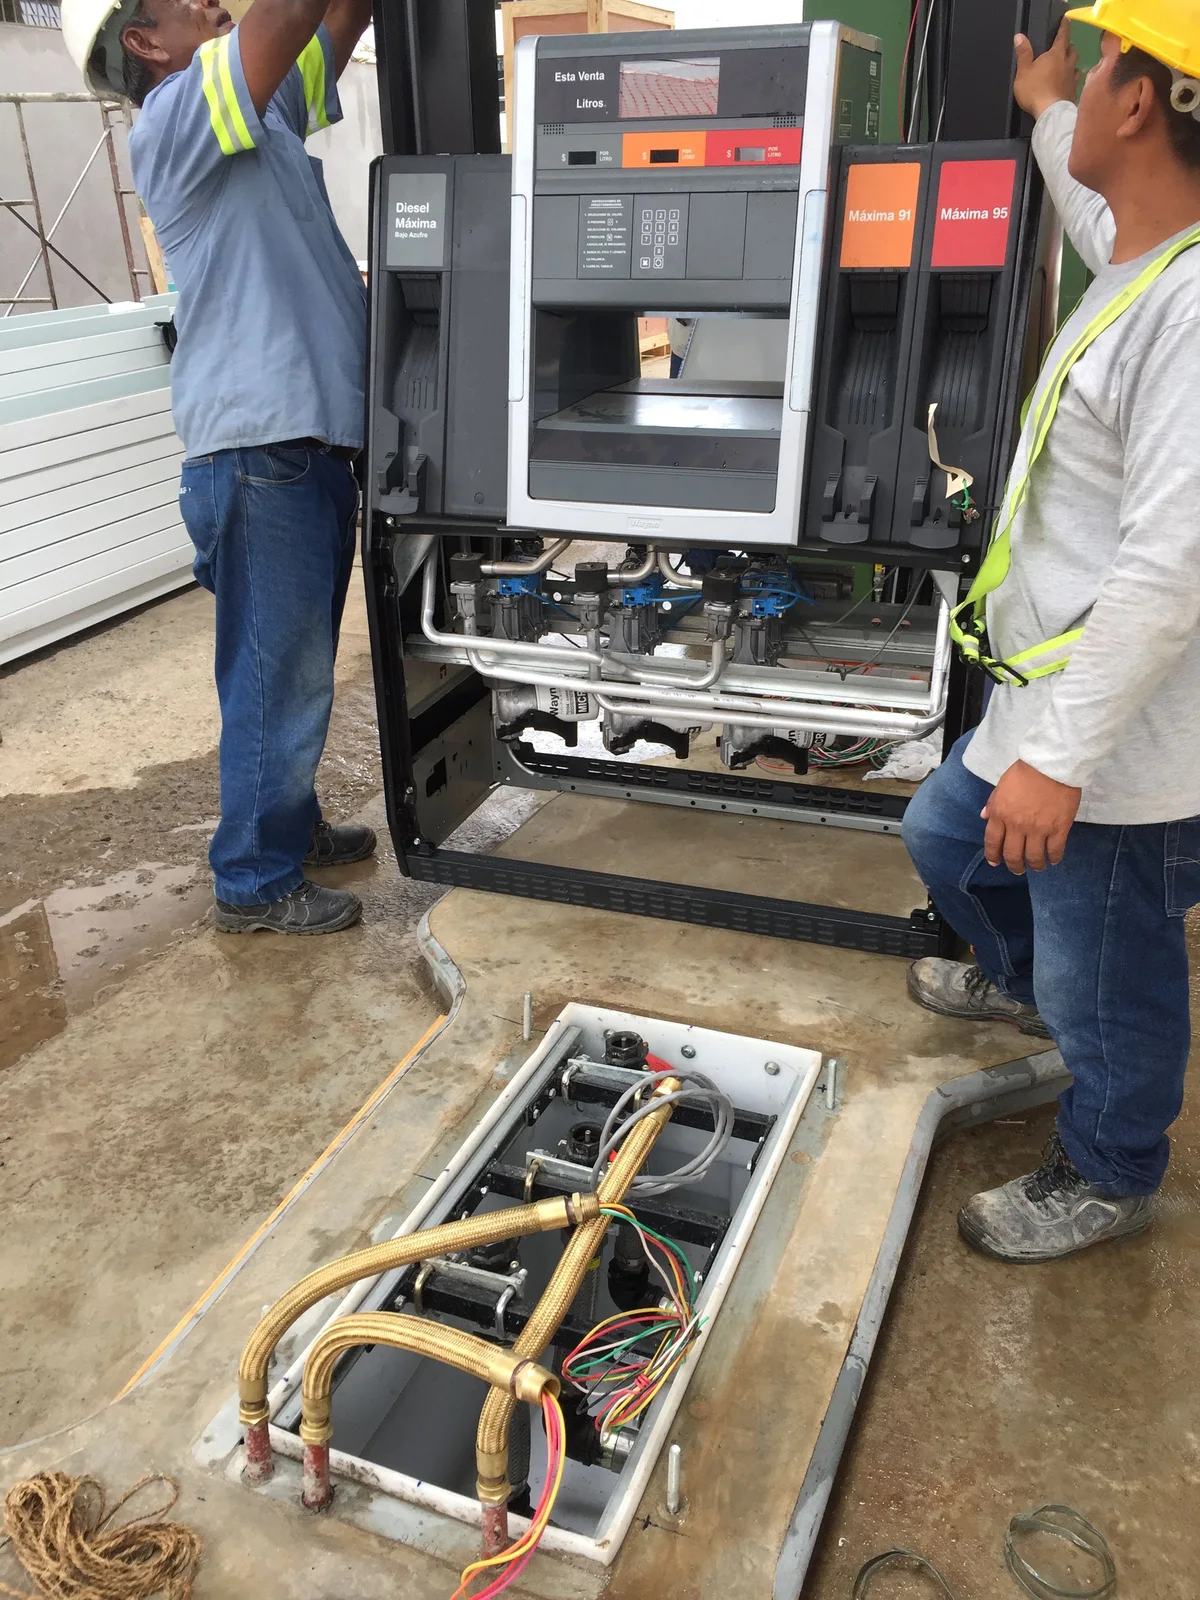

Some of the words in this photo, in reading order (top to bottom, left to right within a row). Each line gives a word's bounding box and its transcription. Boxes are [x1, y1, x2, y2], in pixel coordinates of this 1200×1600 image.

[555, 72, 575, 82] Esta
[578, 71, 605, 81] Venta
[576, 98, 604, 108] Litros
[561, 153, 566, 162] $
[642, 151, 647, 160] $
[726, 149, 731, 158] $
[396, 202, 430, 213] Diesel
[848, 209, 895, 222] Máxima
[898, 209, 911, 221] 91
[941, 207, 989, 221] Máxima
[992, 207, 1008, 219] 95
[395, 217, 437, 229] Máxima
[394, 231, 408, 239] Bajo
[409, 231, 428, 239] Azufre
[631, 518, 660, 529] Wayne
[549, 687, 560, 716] Wayn
[577, 691, 588, 713] MICR
[788, 730, 796, 744] yn
